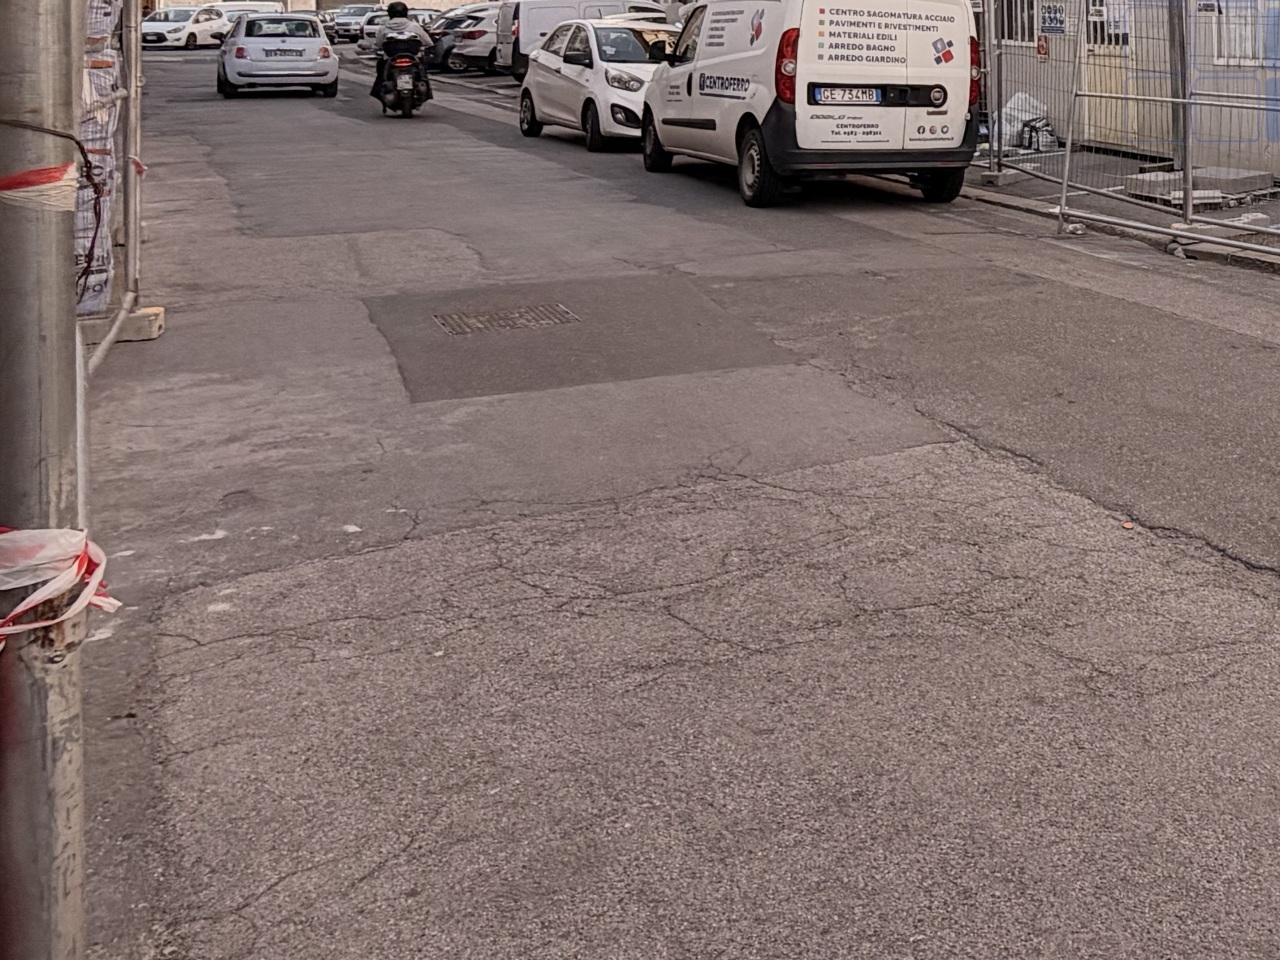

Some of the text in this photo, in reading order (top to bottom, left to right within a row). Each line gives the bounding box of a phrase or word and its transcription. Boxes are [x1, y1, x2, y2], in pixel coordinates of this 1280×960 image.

[829, 8, 955, 23] CENTRO SAGOMATURA ACCIAIO
[829, 20, 876, 29] PAVIMENTI
[884, 23, 939, 32] RIVESTIMENTI
[829, 31, 875, 40] MATERIALI
[828, 42, 896, 52] ARREDO BAGNO
[828, 54, 906, 64] ARREDO GIARDINO
[705, 75, 750, 92] CENTROFERRO
